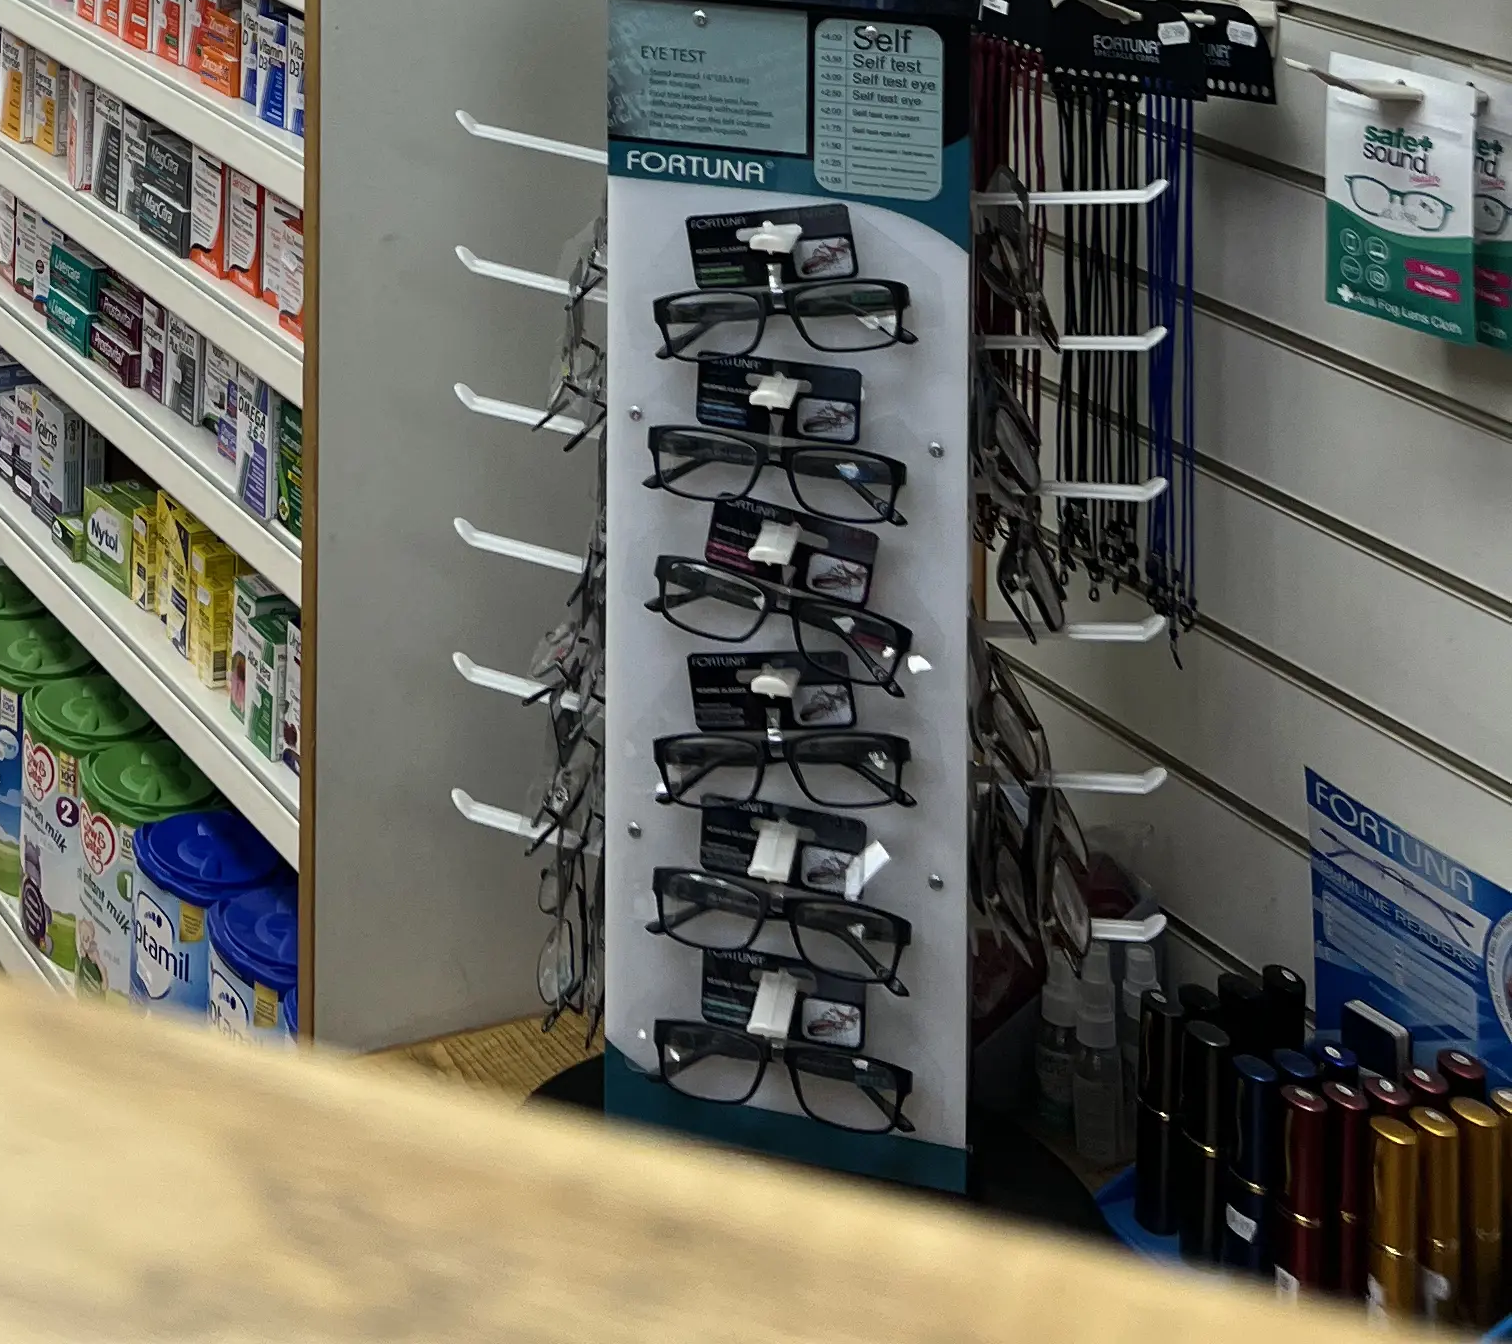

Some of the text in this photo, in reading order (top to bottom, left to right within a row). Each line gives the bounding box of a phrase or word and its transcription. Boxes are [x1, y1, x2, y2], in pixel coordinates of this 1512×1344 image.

[258, 40, 284, 61] Vitamin
[640, 45, 707, 63] EYE TEST
[852, 24, 913, 55] Self
[1093, 34, 1159, 55] FORTUNA
[258, 55, 268, 71] D3
[289, 60, 300, 78] D3
[851, 53, 922, 74] Self test
[851, 72, 937, 94] Self test eye
[851, 89, 922, 107] Self test eye
[1364, 124, 1435, 153] safe+
[150, 143, 180, 176] MagCitra
[626, 150, 766, 184] FORTUNA
[1363, 141, 1430, 176] sound
[143, 192, 173, 225] MagCitra
[691, 216, 747, 230] FORTUNA
[50, 295, 77, 327] Livercare
[1377, 299, 1402, 319] Fog
[1401, 308, 1431, 327] Lens
[1431, 317, 1463, 336] Cloth
[239, 395, 267, 429] OMEGA
[34, 417, 58, 447] Kalms
[91, 518, 119, 553] Nytol
[691, 655, 748, 668] FORTUNA
[60, 799, 73, 818] 2
[44, 821, 68, 855] milk
[1315, 780, 1475, 905] FORTUNA
[105, 899, 132, 936] milk
[1394, 908, 1479, 972] READERS
